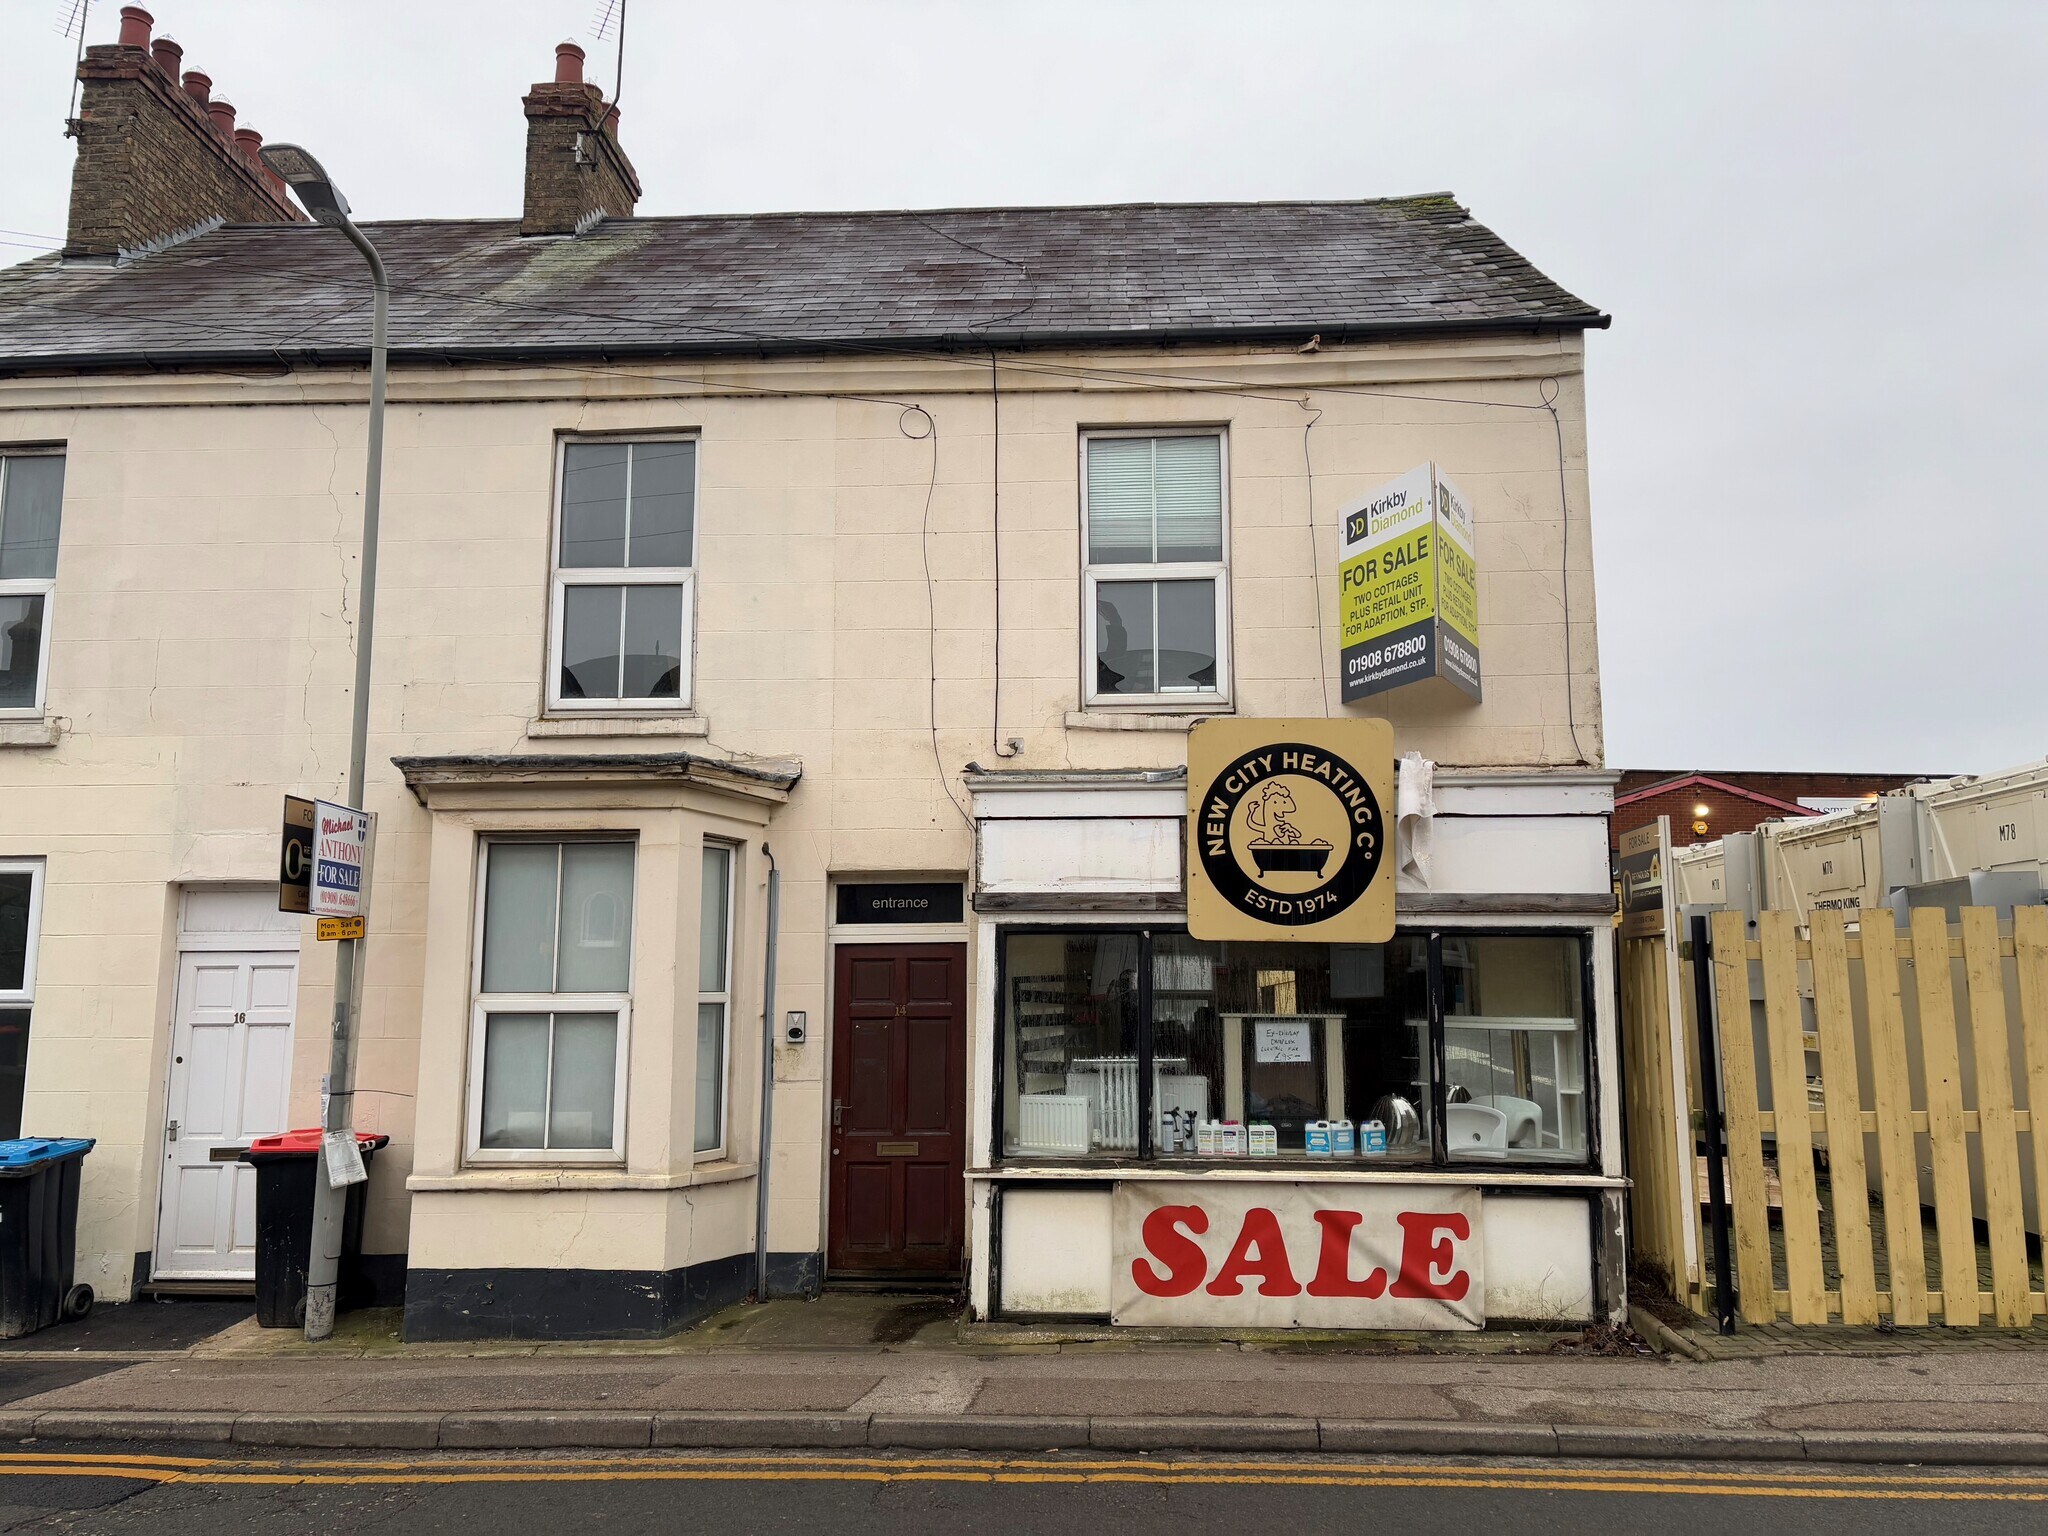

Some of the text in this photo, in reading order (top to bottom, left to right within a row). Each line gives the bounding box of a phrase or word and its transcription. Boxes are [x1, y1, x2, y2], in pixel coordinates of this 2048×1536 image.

[1371, 490, 1407, 518] Kirkby
[1371, 497, 1423, 535] Diamond
[1343, 535, 1429, 592] FOR SALE
[1439, 535, 1475, 591] FOR SALE
[1350, 584, 1423, 622] PLUS RETAIL UNIT
[1353, 571, 1419, 607] TWO COTTAGES
[1345, 598, 1429, 637] FOR ADAPTION, STP.
[1348, 634, 1426, 675] 01908 678800
[1444, 635, 1460, 661] 01908
[1349, 656, 1427, 688] www.kirkbydiamond.co.uk
[1207, 796, 1230, 856] NEW
[1225, 753, 1273, 793] CITY
[1283, 751, 1373, 824] HEATING
[322, 815, 354, 836] Michael
[1998, 823, 2017, 842] M78
[318, 838, 363, 864] ANTHONY
[1628, 832, 1650, 849] FOR SALE
[319, 864, 359, 888] FOR SALE
[872, 897, 929, 909] entrance
[1244, 888, 1338, 915] ESTD 1974
[1814, 897, 1860, 910] THERMO KING
[233, 1012, 246, 1024] 16
[1131, 1204, 1471, 1302] SALE
